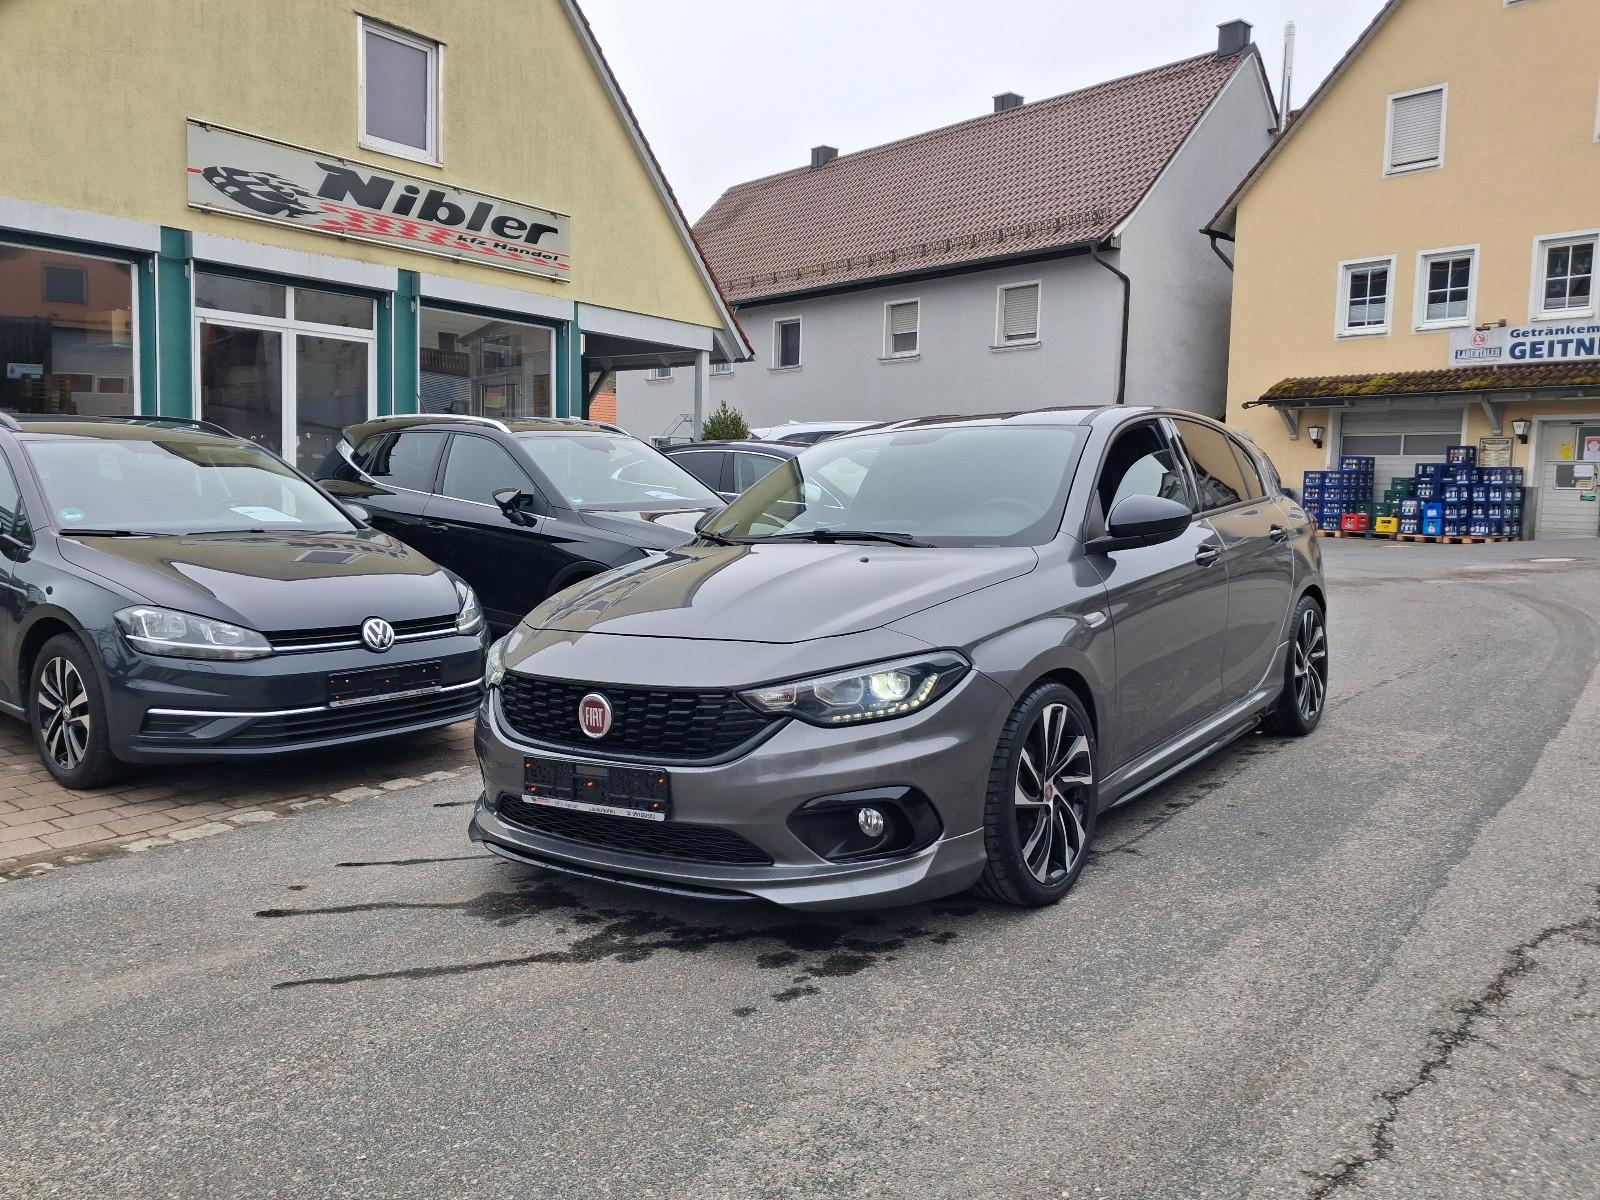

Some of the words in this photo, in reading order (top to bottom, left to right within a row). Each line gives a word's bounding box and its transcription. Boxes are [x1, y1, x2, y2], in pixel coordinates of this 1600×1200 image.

[315, 161, 559, 245] Nibler
[457, 235, 487, 246] kfz
[493, 241, 559, 262] Handel
[1508, 336, 1600, 360] GEITN
[585, 706, 604, 728] FIAT
